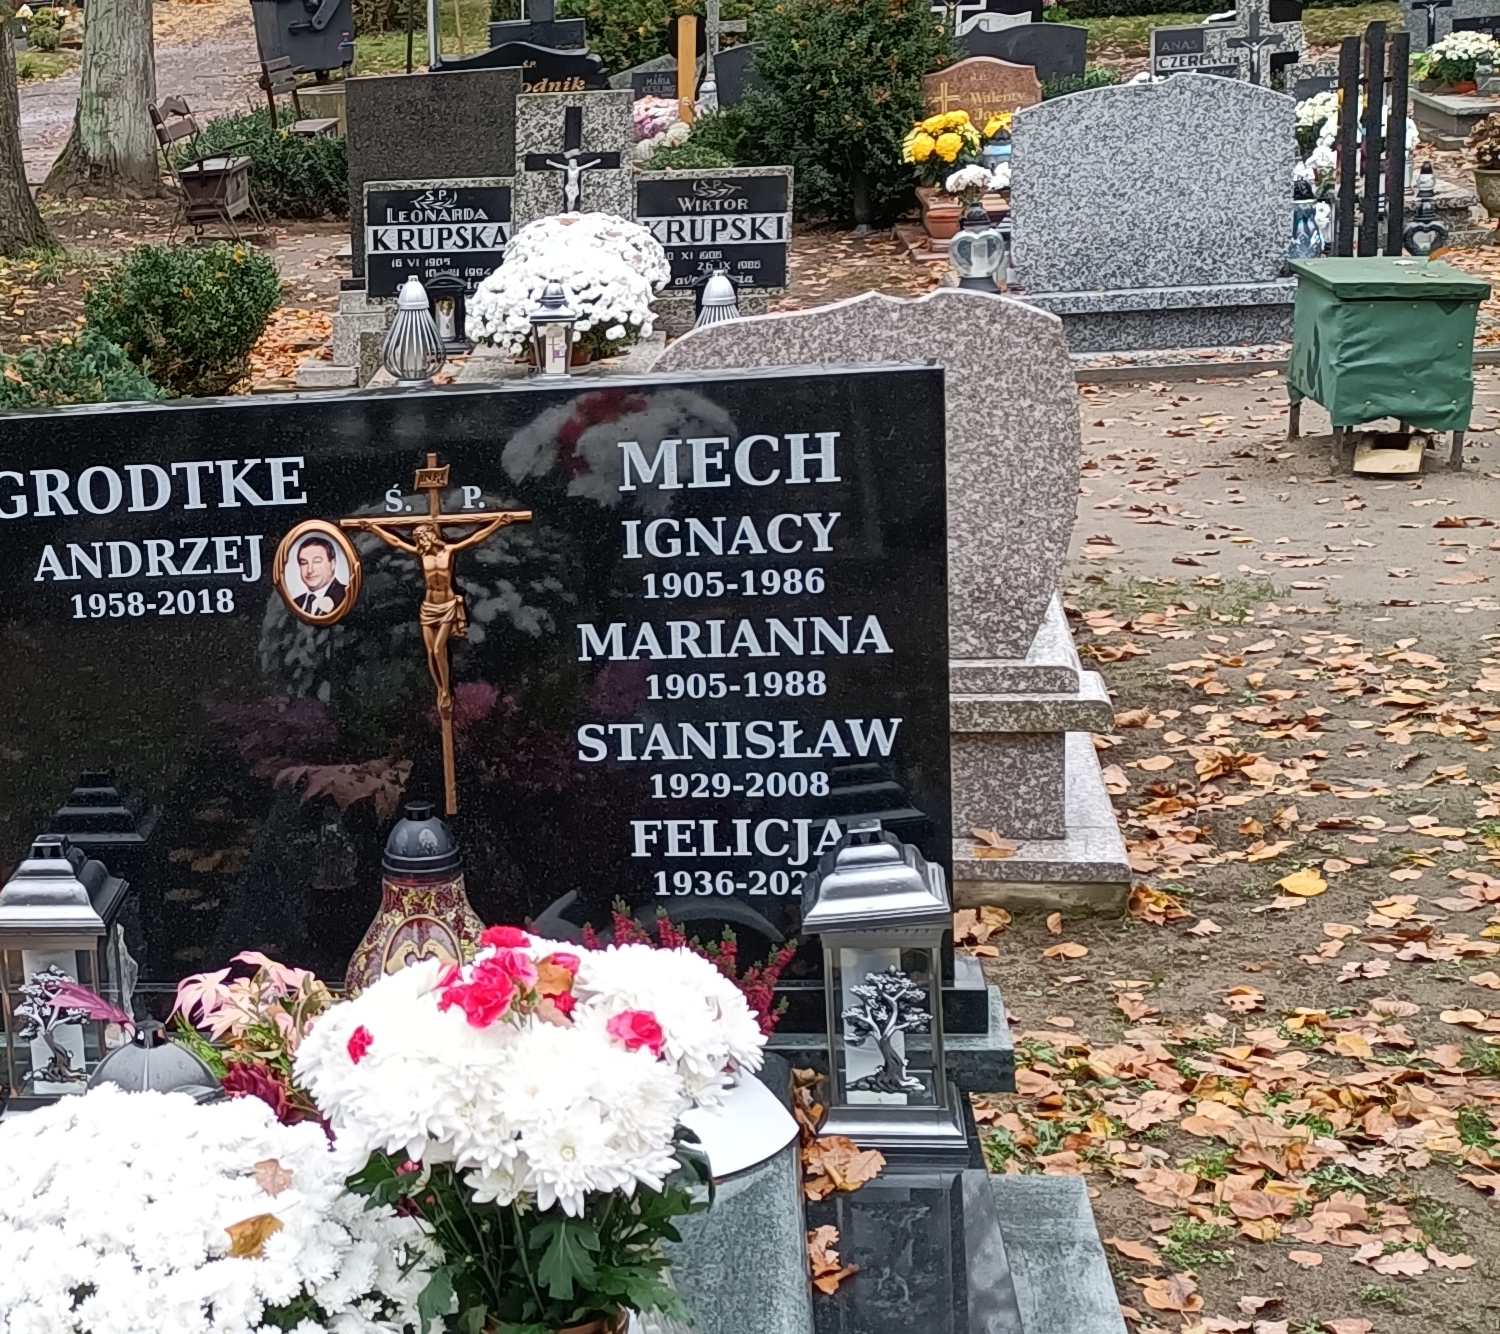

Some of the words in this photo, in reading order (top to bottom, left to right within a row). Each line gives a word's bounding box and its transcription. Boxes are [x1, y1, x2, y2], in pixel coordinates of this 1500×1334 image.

[522, 76, 586, 93] odnik
[386, 207, 489, 224] LEONARDA
[677, 196, 749, 213] WIKTOR
[372, 225, 510, 252] KRUPSKA
[644, 216, 785, 245] KRUPSKI
[406, 257, 420, 267] VI
[617, 431, 842, 492] MECH
[385, 483, 412, 512] Ś.
[461, 485, 486, 509] P.
[621, 512, 842, 559] IGNACY
[33, 535, 264, 582] ANDRZEJ
[642, 567, 826, 599] 1905-1986
[70, 588, 235, 619] 1958-2018
[576, 615, 894, 662] MARIANNA
[646, 670, 827, 700] 1905-1988
[577, 718, 903, 762] STANISŁAW
[650, 771, 830, 799] 1929-2008
[629, 818, 843, 866] FELICJA
[653, 870, 808, 896] 1936-202
